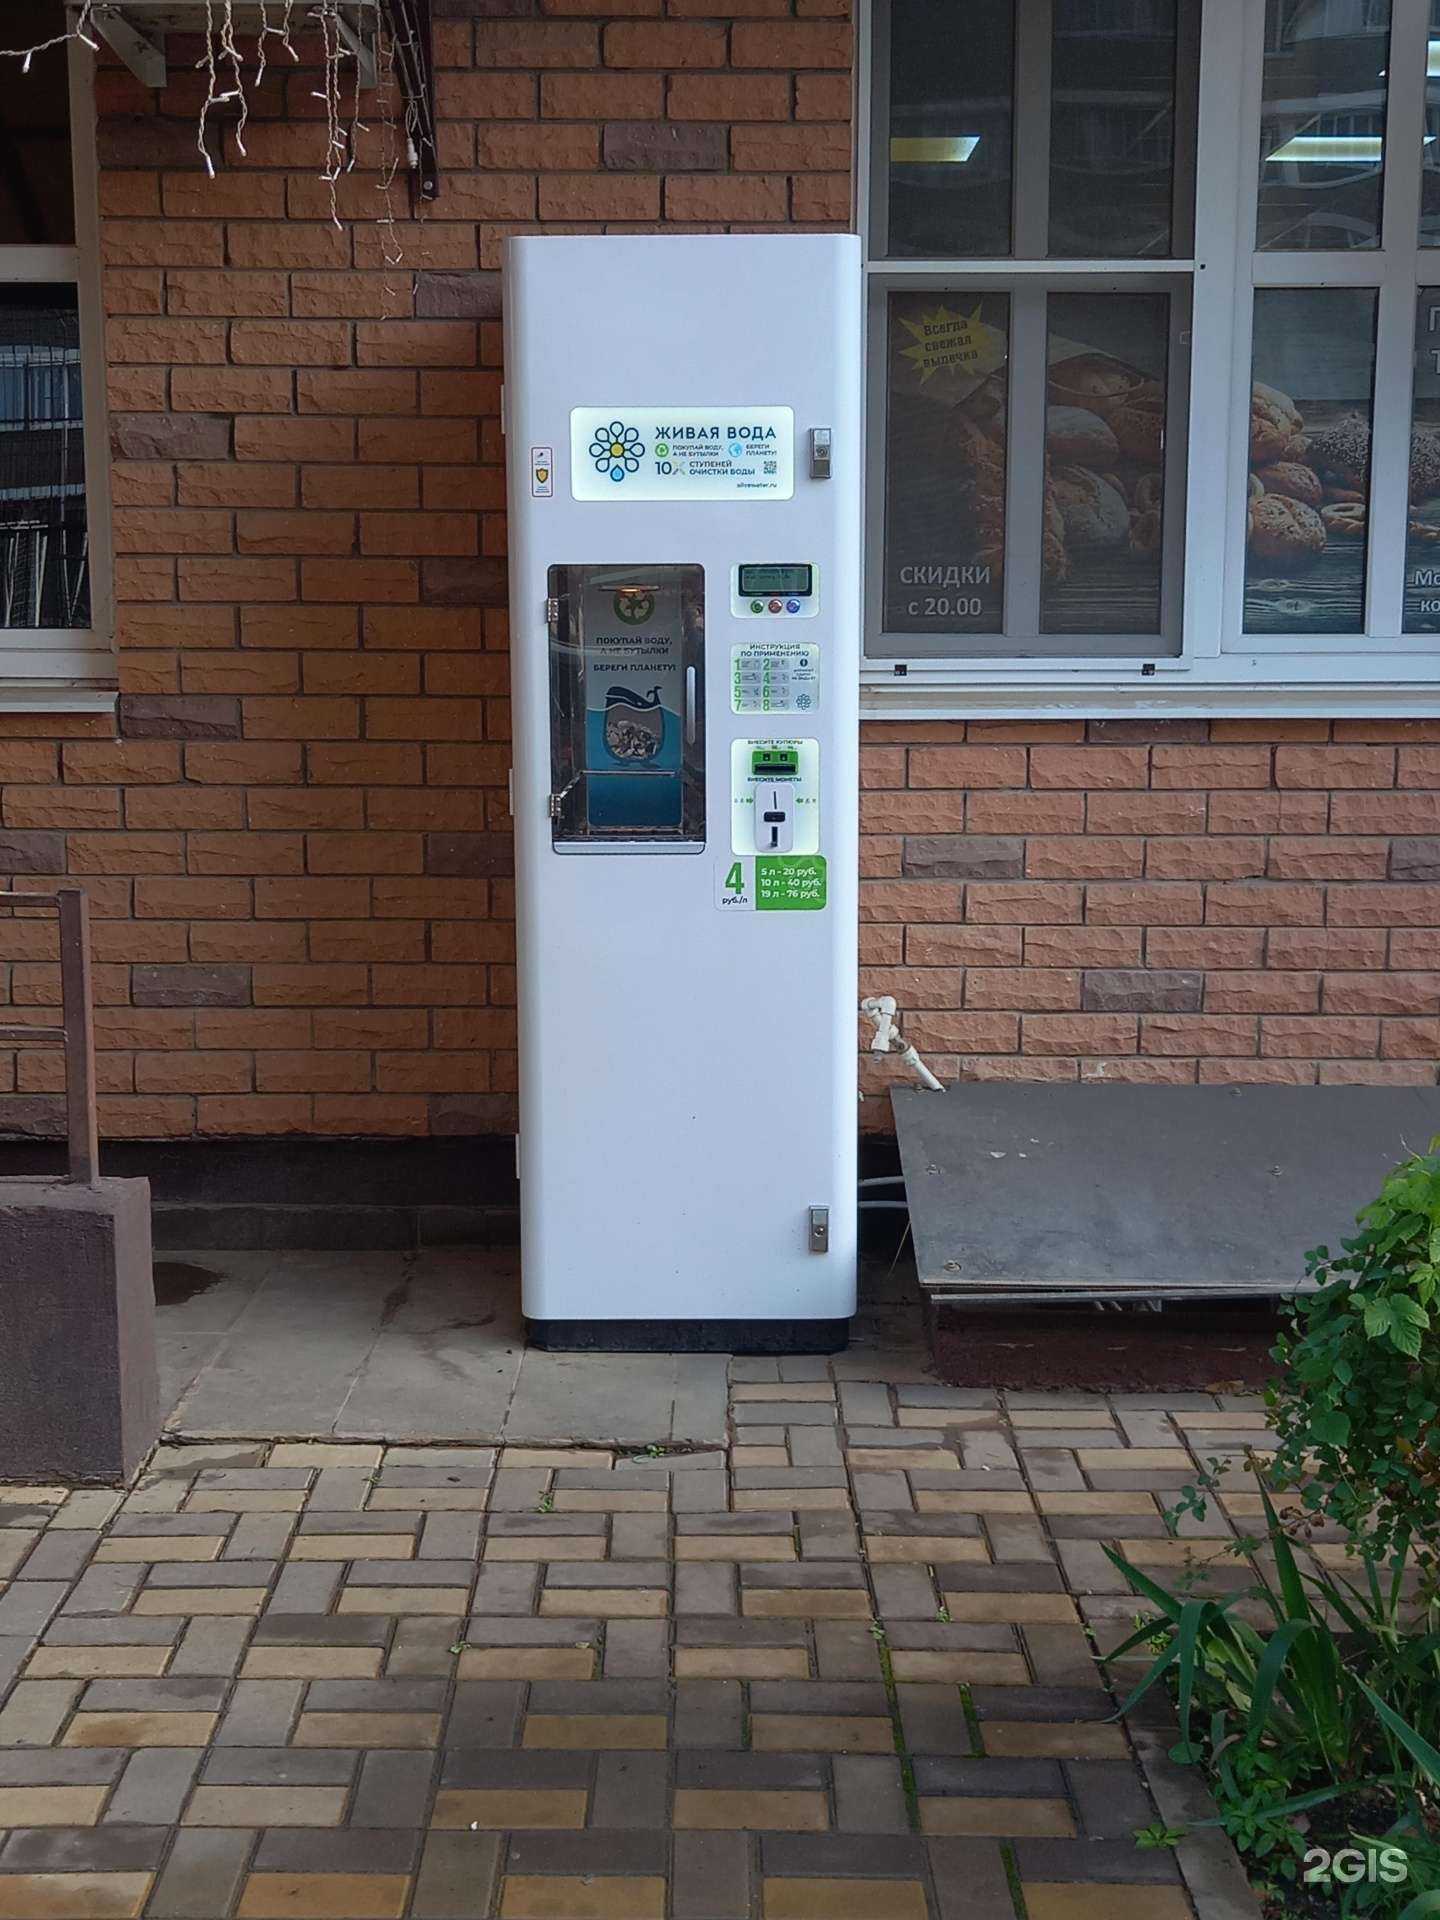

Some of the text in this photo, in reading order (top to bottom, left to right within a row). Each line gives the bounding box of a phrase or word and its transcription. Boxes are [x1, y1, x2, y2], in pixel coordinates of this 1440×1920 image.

[655, 426, 777, 441] ЖИВАЯ ВОДА
[672, 443, 703, 451] ПОКУПАЙ
[689, 459, 733, 468] СТУПЕНЕЙ
[900, 566, 991, 588] СКИДКИ
[908, 597, 982, 616] с 20.00
[596, 635, 642, 645] ПОКУПАЙ
[734, 659, 740, 671] 1
[763, 658, 770, 671] 2
[734, 672, 741, 684] 3
[763, 672, 770, 684] 4
[734, 685, 741, 698] 5
[763, 685, 770, 698] 6
[734, 699, 741, 711] 7
[763, 699, 770, 711] 8
[761, 867, 767, 876] 5
[782, 867, 795, 876] 20
[796, 866, 817, 877] руб.
[725, 862, 745, 894] 4
[761, 878, 771, 887] 10
[787, 878, 800, 887] 40
[801, 877, 822, 888] руб.
[761, 889, 771, 898] 19
[786, 889, 798, 898] 76
[800, 888, 820, 899] руб.
[722, 895, 748, 905] руб./л
